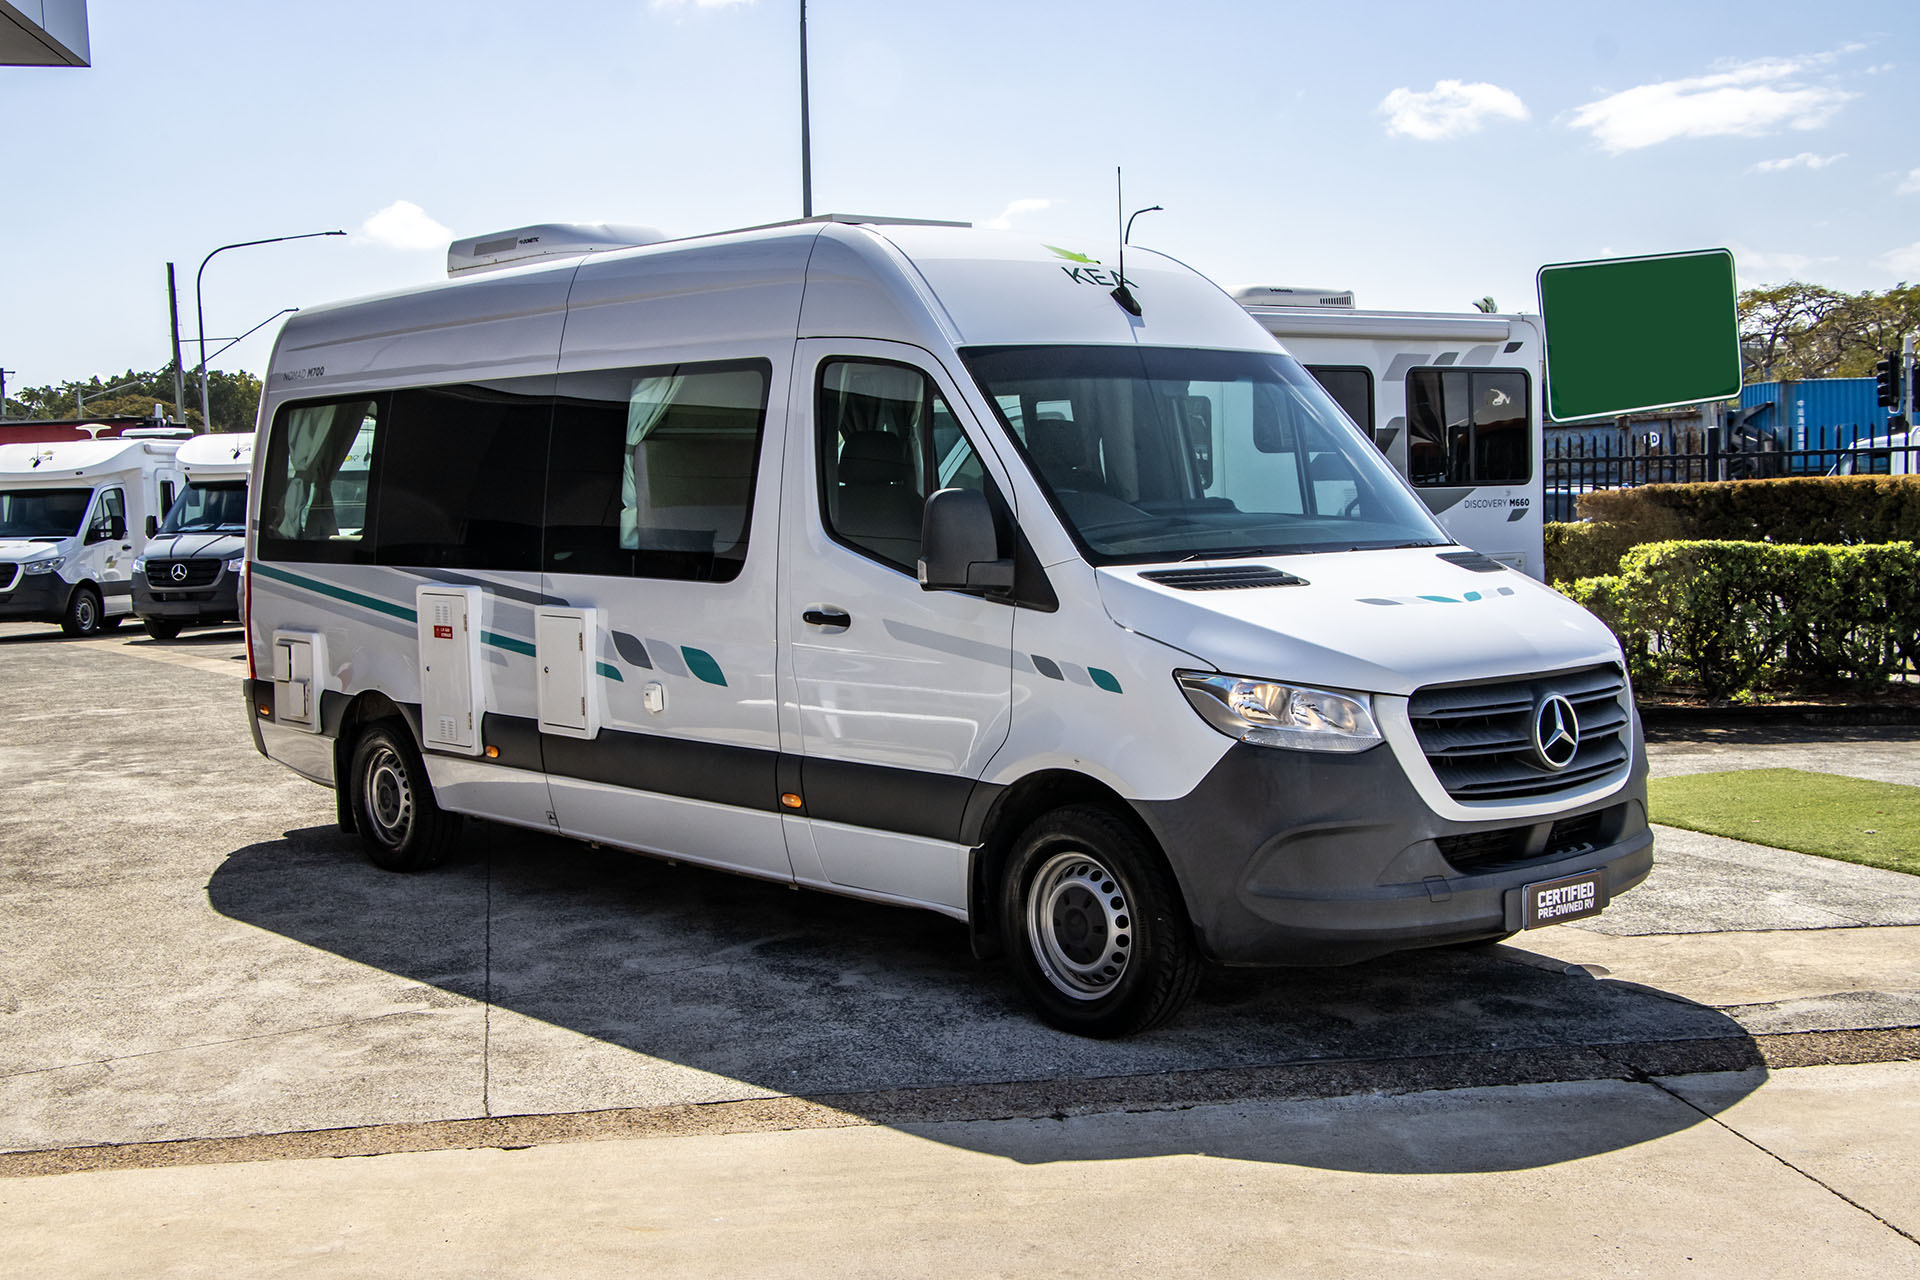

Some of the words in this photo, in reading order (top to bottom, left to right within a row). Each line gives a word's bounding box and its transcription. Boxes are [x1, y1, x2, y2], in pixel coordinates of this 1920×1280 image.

[1061, 266, 1139, 288] KEA
[307, 366, 325, 377] M700
[1465, 499, 1507, 508] DISCOVERY
[1509, 498, 1529, 506] M660
[1538, 882, 1594, 908] CERTIFIED
[1538, 900, 1583, 919] PRE-OWNED
[1584, 898, 1594, 909] RV
